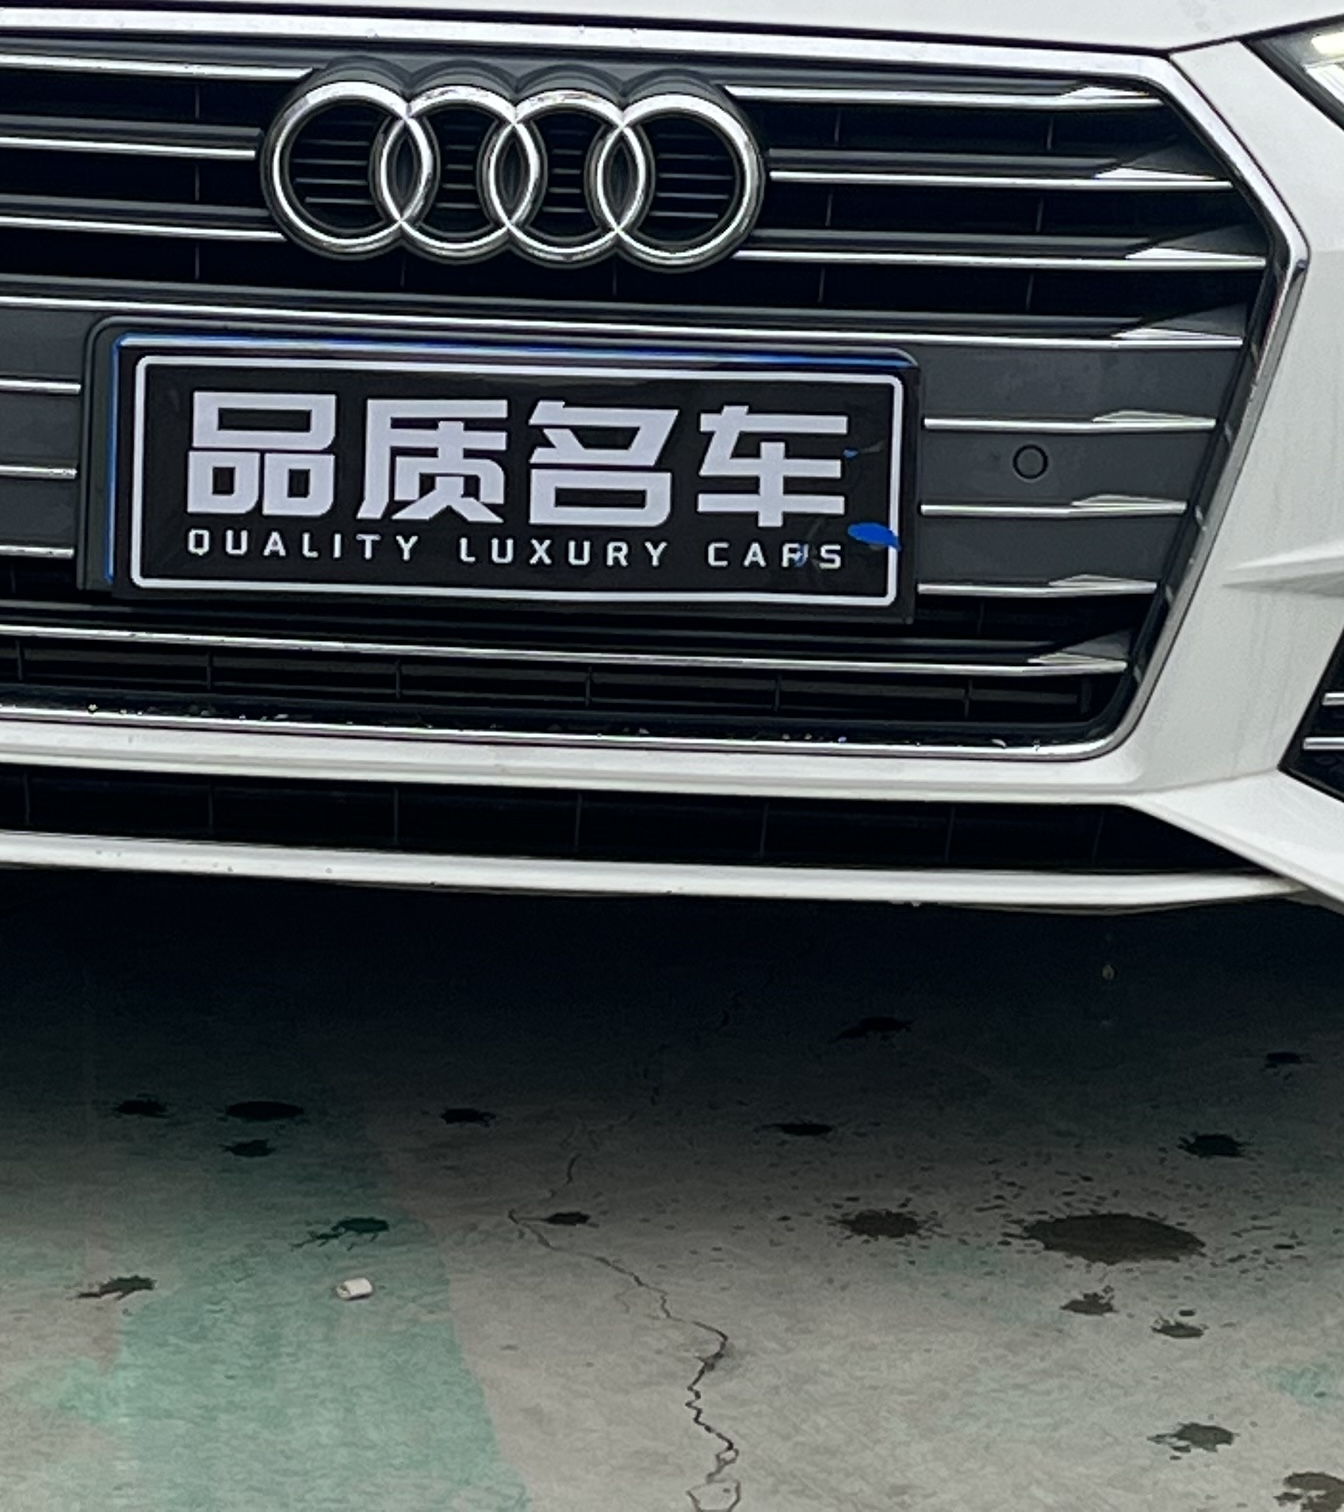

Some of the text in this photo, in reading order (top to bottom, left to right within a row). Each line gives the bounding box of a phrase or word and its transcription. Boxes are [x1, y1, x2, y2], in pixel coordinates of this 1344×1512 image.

[187, 391, 848, 527] 品质名车
[188, 528, 842, 569] QUALITY LUXURY CARS
